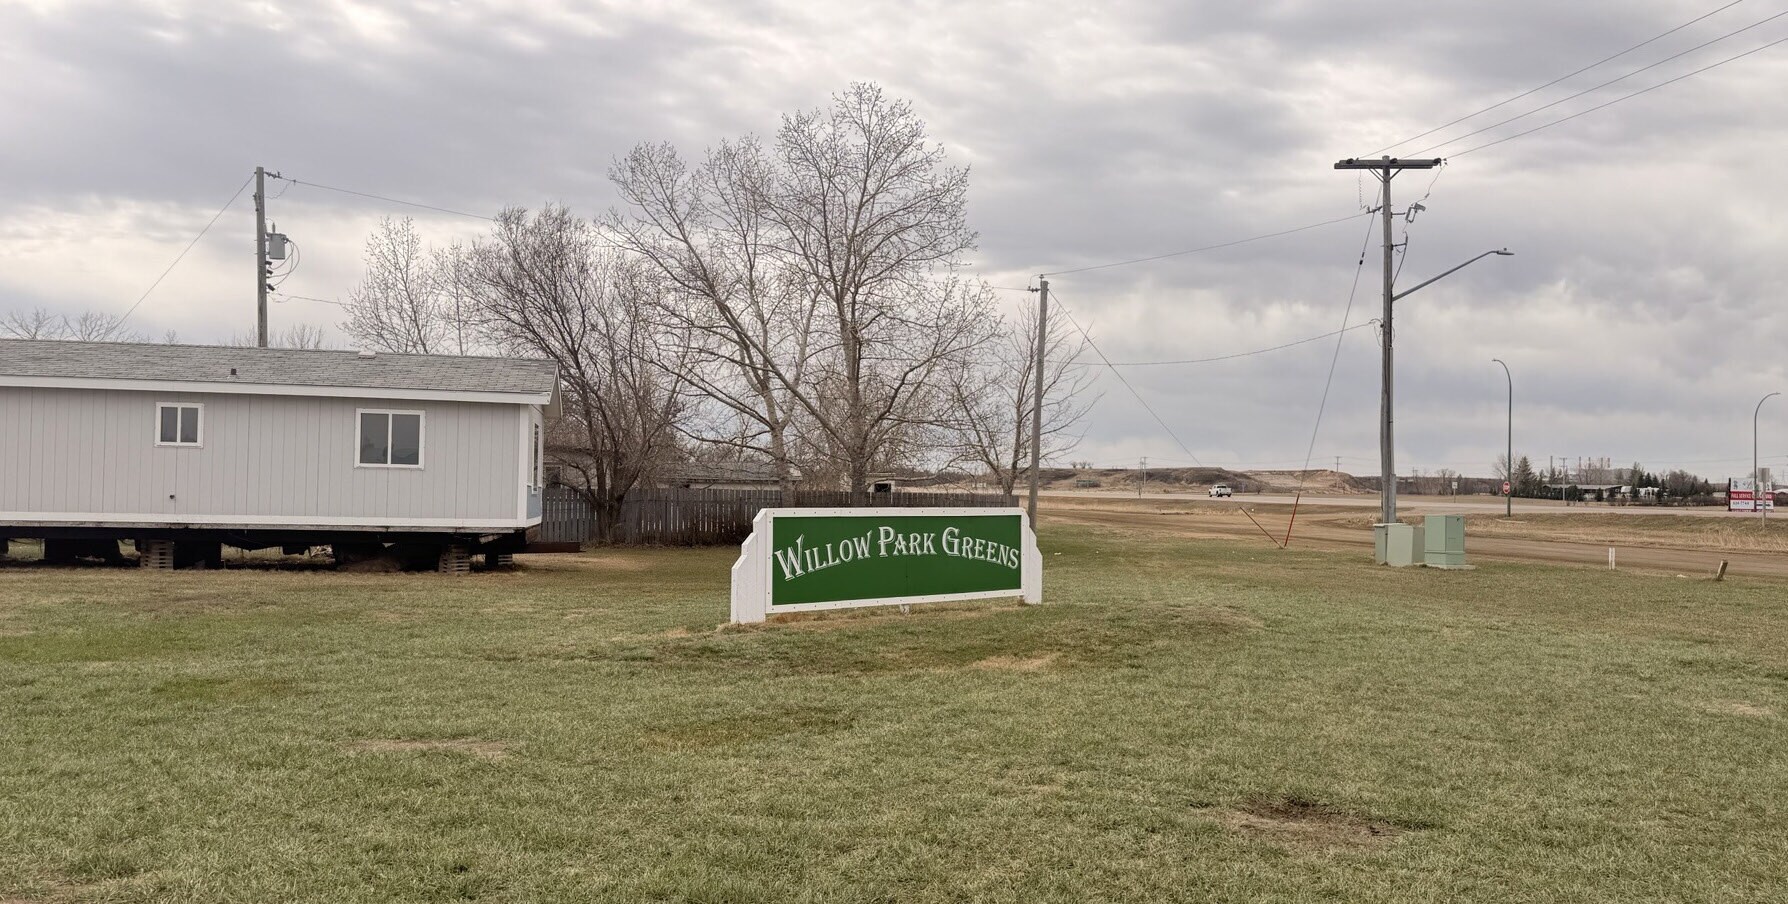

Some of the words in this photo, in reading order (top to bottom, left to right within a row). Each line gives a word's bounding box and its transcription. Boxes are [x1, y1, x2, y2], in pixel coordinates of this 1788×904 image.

[774, 530, 873, 582] WILLOW
[878, 526, 937, 557] PARK
[941, 526, 1020, 570] GREENS
